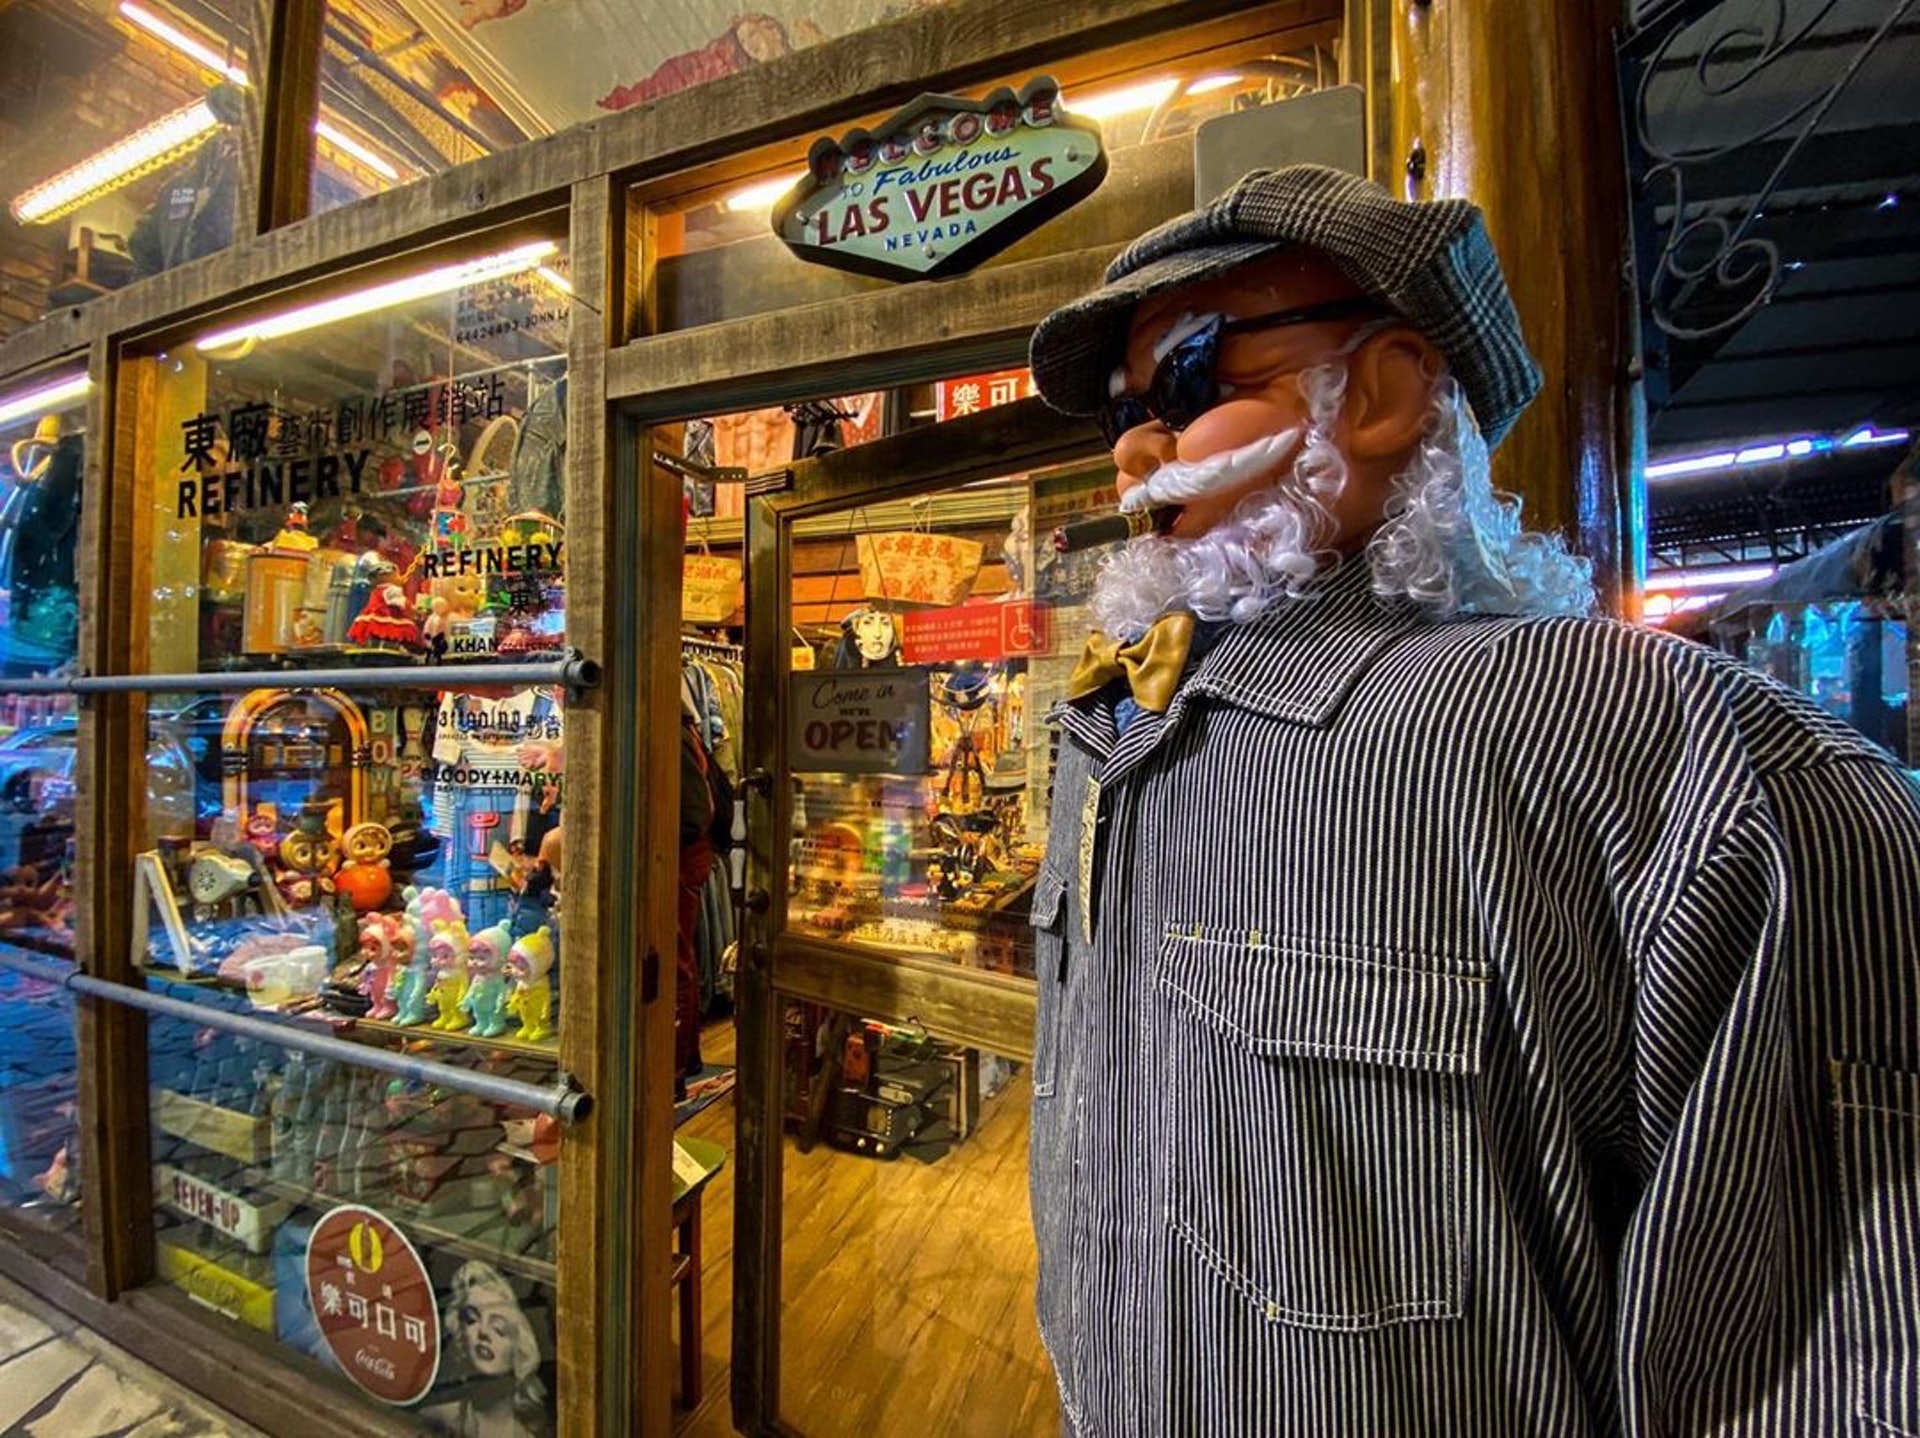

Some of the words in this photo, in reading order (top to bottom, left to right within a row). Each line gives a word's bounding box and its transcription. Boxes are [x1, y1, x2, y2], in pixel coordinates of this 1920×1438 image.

[816, 97, 1054, 178] WELCOME
[872, 146, 1021, 196] Fabulous
[816, 196, 890, 246] LAS
[904, 156, 1055, 224] VEGAS
[884, 219, 977, 251] NEVADA
[177, 449, 371, 519] REFINERY
[423, 540, 563, 579] REFINERY
[453, 636, 500, 653] KHAN
[812, 678, 869, 710] Come
[876, 680, 895, 699] in
[804, 719, 905, 752] OPEN
[172, 1176, 241, 1233] SEVEN-UP
